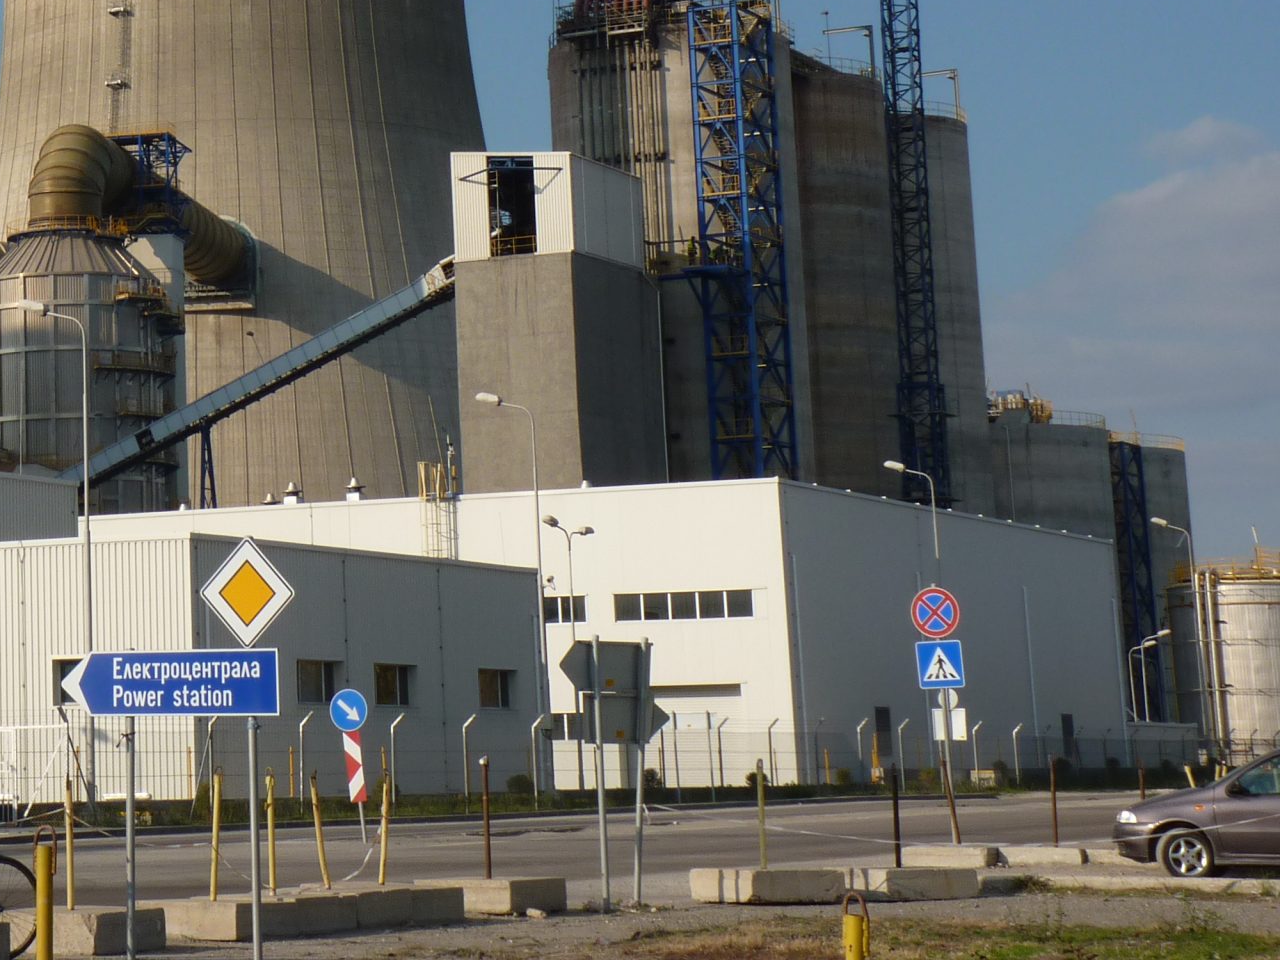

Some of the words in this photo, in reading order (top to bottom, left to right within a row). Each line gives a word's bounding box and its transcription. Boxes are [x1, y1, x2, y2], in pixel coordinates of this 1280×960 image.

[112, 657, 261, 685] Електроцентрала
[112, 685, 165, 708] Power
[172, 684, 233, 707] station
